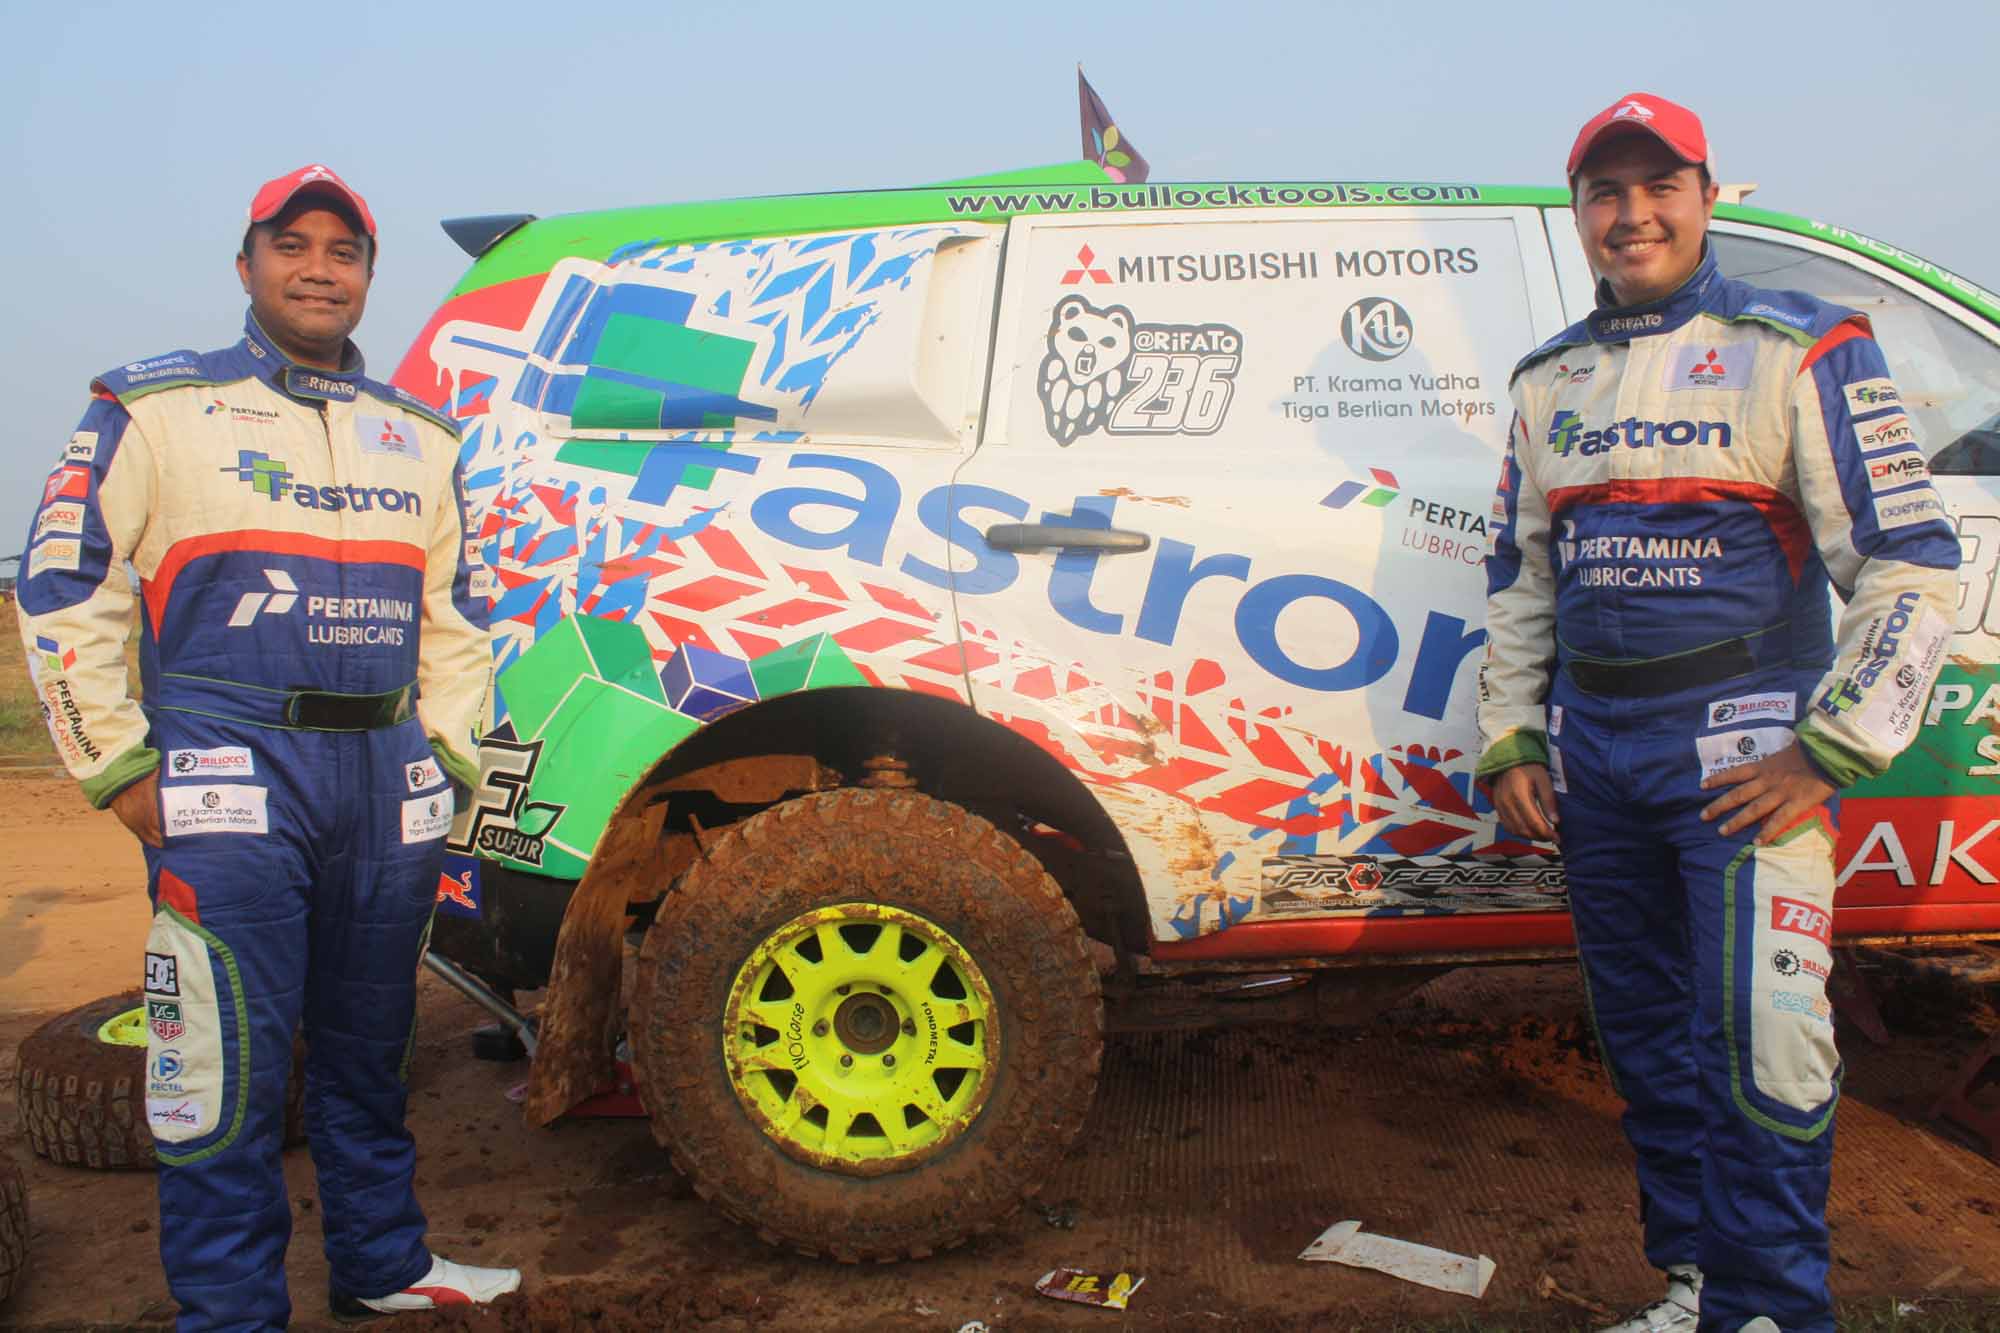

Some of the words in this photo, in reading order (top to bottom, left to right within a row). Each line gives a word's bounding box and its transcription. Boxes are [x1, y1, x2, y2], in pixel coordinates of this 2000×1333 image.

[947, 183, 1480, 214] www.bullocktools.com
[1119, 252, 1318, 284] MITSUBISHI
[1336, 247, 1479, 278] MOTORS
[1109, 354, 1239, 434] 236
[1293, 376, 1320, 393] PT.
[1328, 375, 1403, 393] Krama
[1409, 374, 1481, 391] Yudha
[1282, 402, 1330, 423] Tiga
[1337, 400, 1414, 419] Berlian
[1420, 400, 1497, 417] Motors
[1560, 416, 1732, 457] Fastron
[270, 470, 422, 517] Fastron
[1409, 498, 1488, 537] PERTA
[1401, 528, 1487, 567] LUBRIC
[1578, 536, 1723, 559] PERTAMINA
[1577, 567, 1702, 587] LUBRICANTS
[308, 597, 413, 622] PERTAMINA
[308, 625, 404, 646] LUBRICANTS
[56, 679, 102, 763] PERTAMINA
[172, 818, 193, 828] Tiga
[191, 808, 223, 816] Krama
[225, 807, 253, 816] Yudha
[151, 1003, 177, 1019] TAG
[920, 1001, 938, 1066] FONDMETAL
